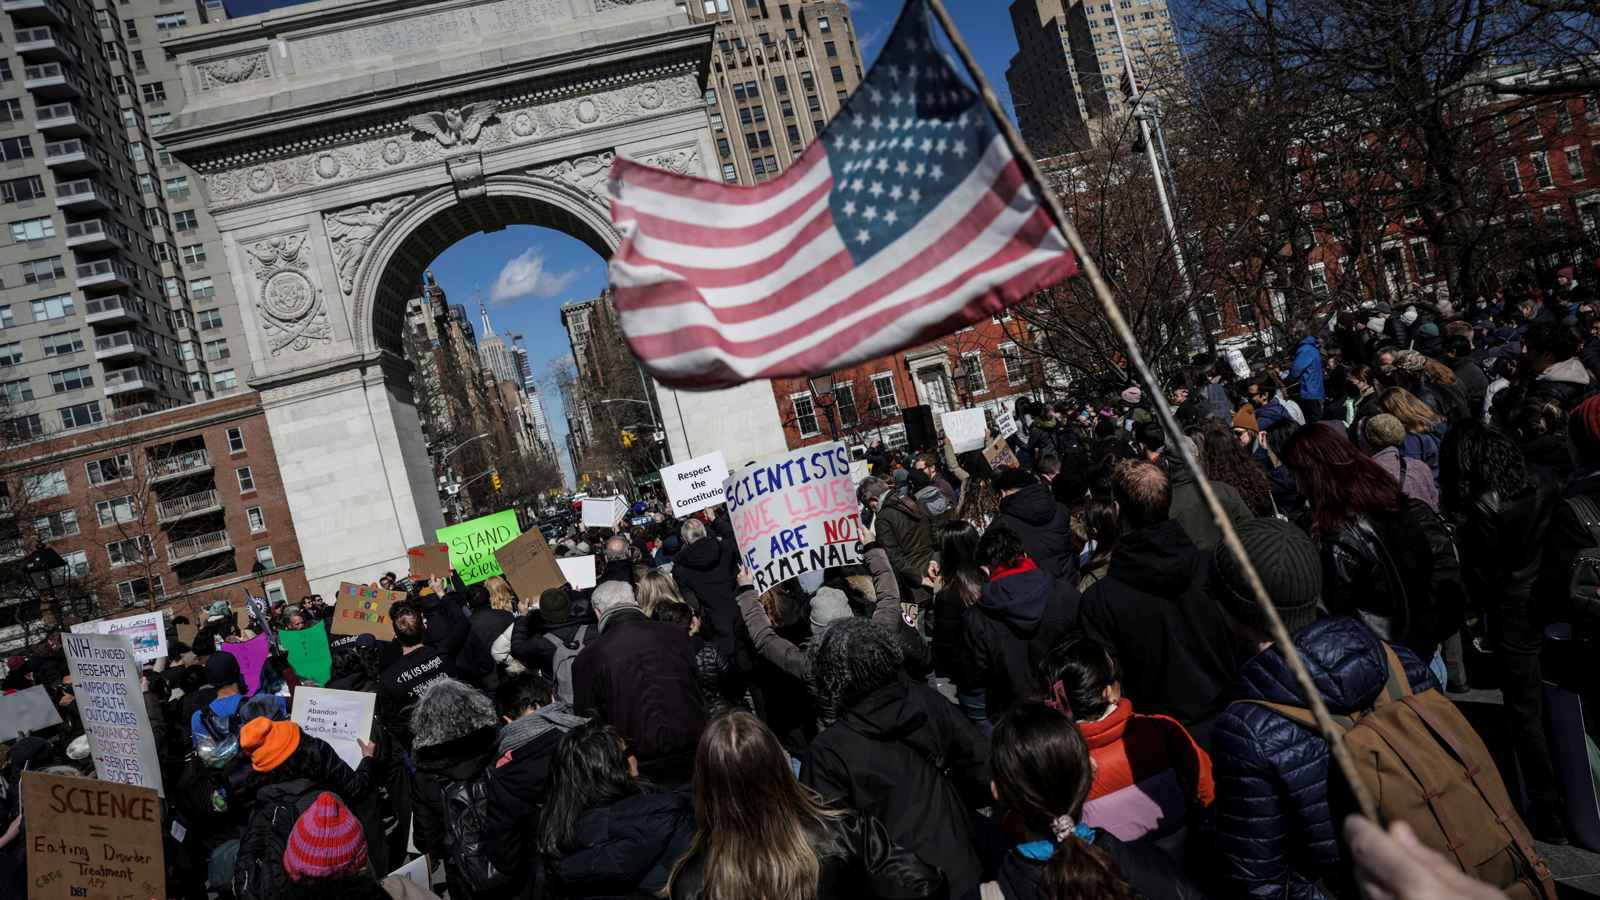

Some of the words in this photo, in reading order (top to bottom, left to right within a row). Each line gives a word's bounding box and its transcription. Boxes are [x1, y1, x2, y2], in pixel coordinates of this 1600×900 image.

[677, 464, 712, 481] Respect
[726, 446, 850, 512] SCIENTISTS
[691, 480, 706, 490] the
[676, 487, 724, 508] Constitutio
[784, 479, 857, 515] LIVES
[452, 525, 511, 555] STAND
[770, 523, 809, 559] ARE
[823, 513, 860, 545] NOT
[462, 552, 482, 567] UP
[755, 540, 865, 593] RIMINALS
[67, 638, 93, 658] NIH
[94, 648, 126, 660] FUNDED
[77, 663, 126, 677] RESEARCH
[410, 666, 422, 678] US
[420, 655, 443, 672] Budget
[81, 680, 128, 696] IMPROVES
[90, 696, 126, 710] HEALTH
[308, 708, 338, 716] Abandon
[85, 708, 137, 725] OUTCOMES
[104, 755, 140, 772] SERVES
[106, 769, 144, 785] SOCIETY
[49, 784, 155, 822] SCIENCE
[34, 835, 90, 862] Eating
[103, 843, 153, 865] Disorder
[69, 860, 134, 882] Treatment
